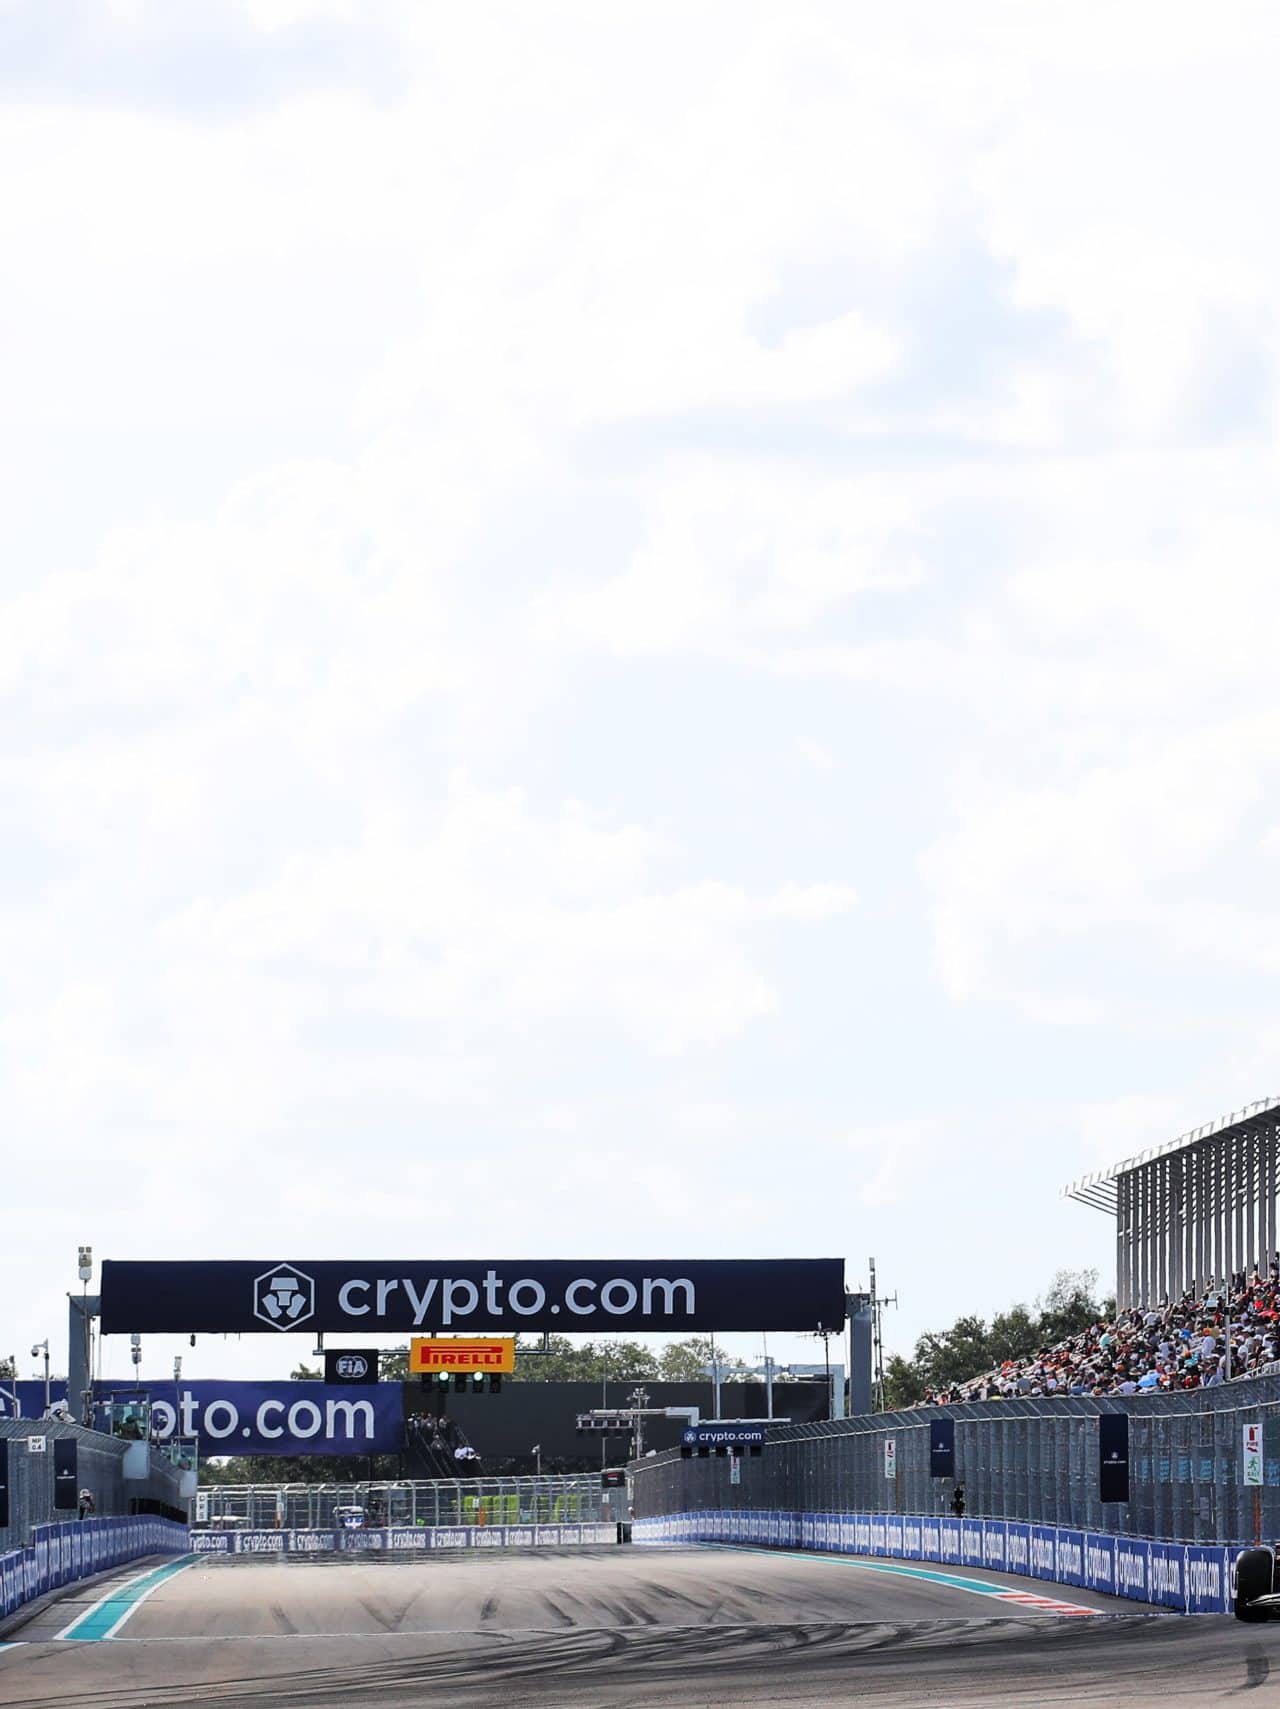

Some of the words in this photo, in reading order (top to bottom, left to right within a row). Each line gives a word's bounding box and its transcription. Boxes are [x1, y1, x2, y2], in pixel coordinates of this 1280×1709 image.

[338, 1271, 695, 1326] crypto.com
[421, 1346, 503, 1364] PIRELLI
[338, 1359, 365, 1373] FIA
[698, 1431, 762, 1442] crypto.com
